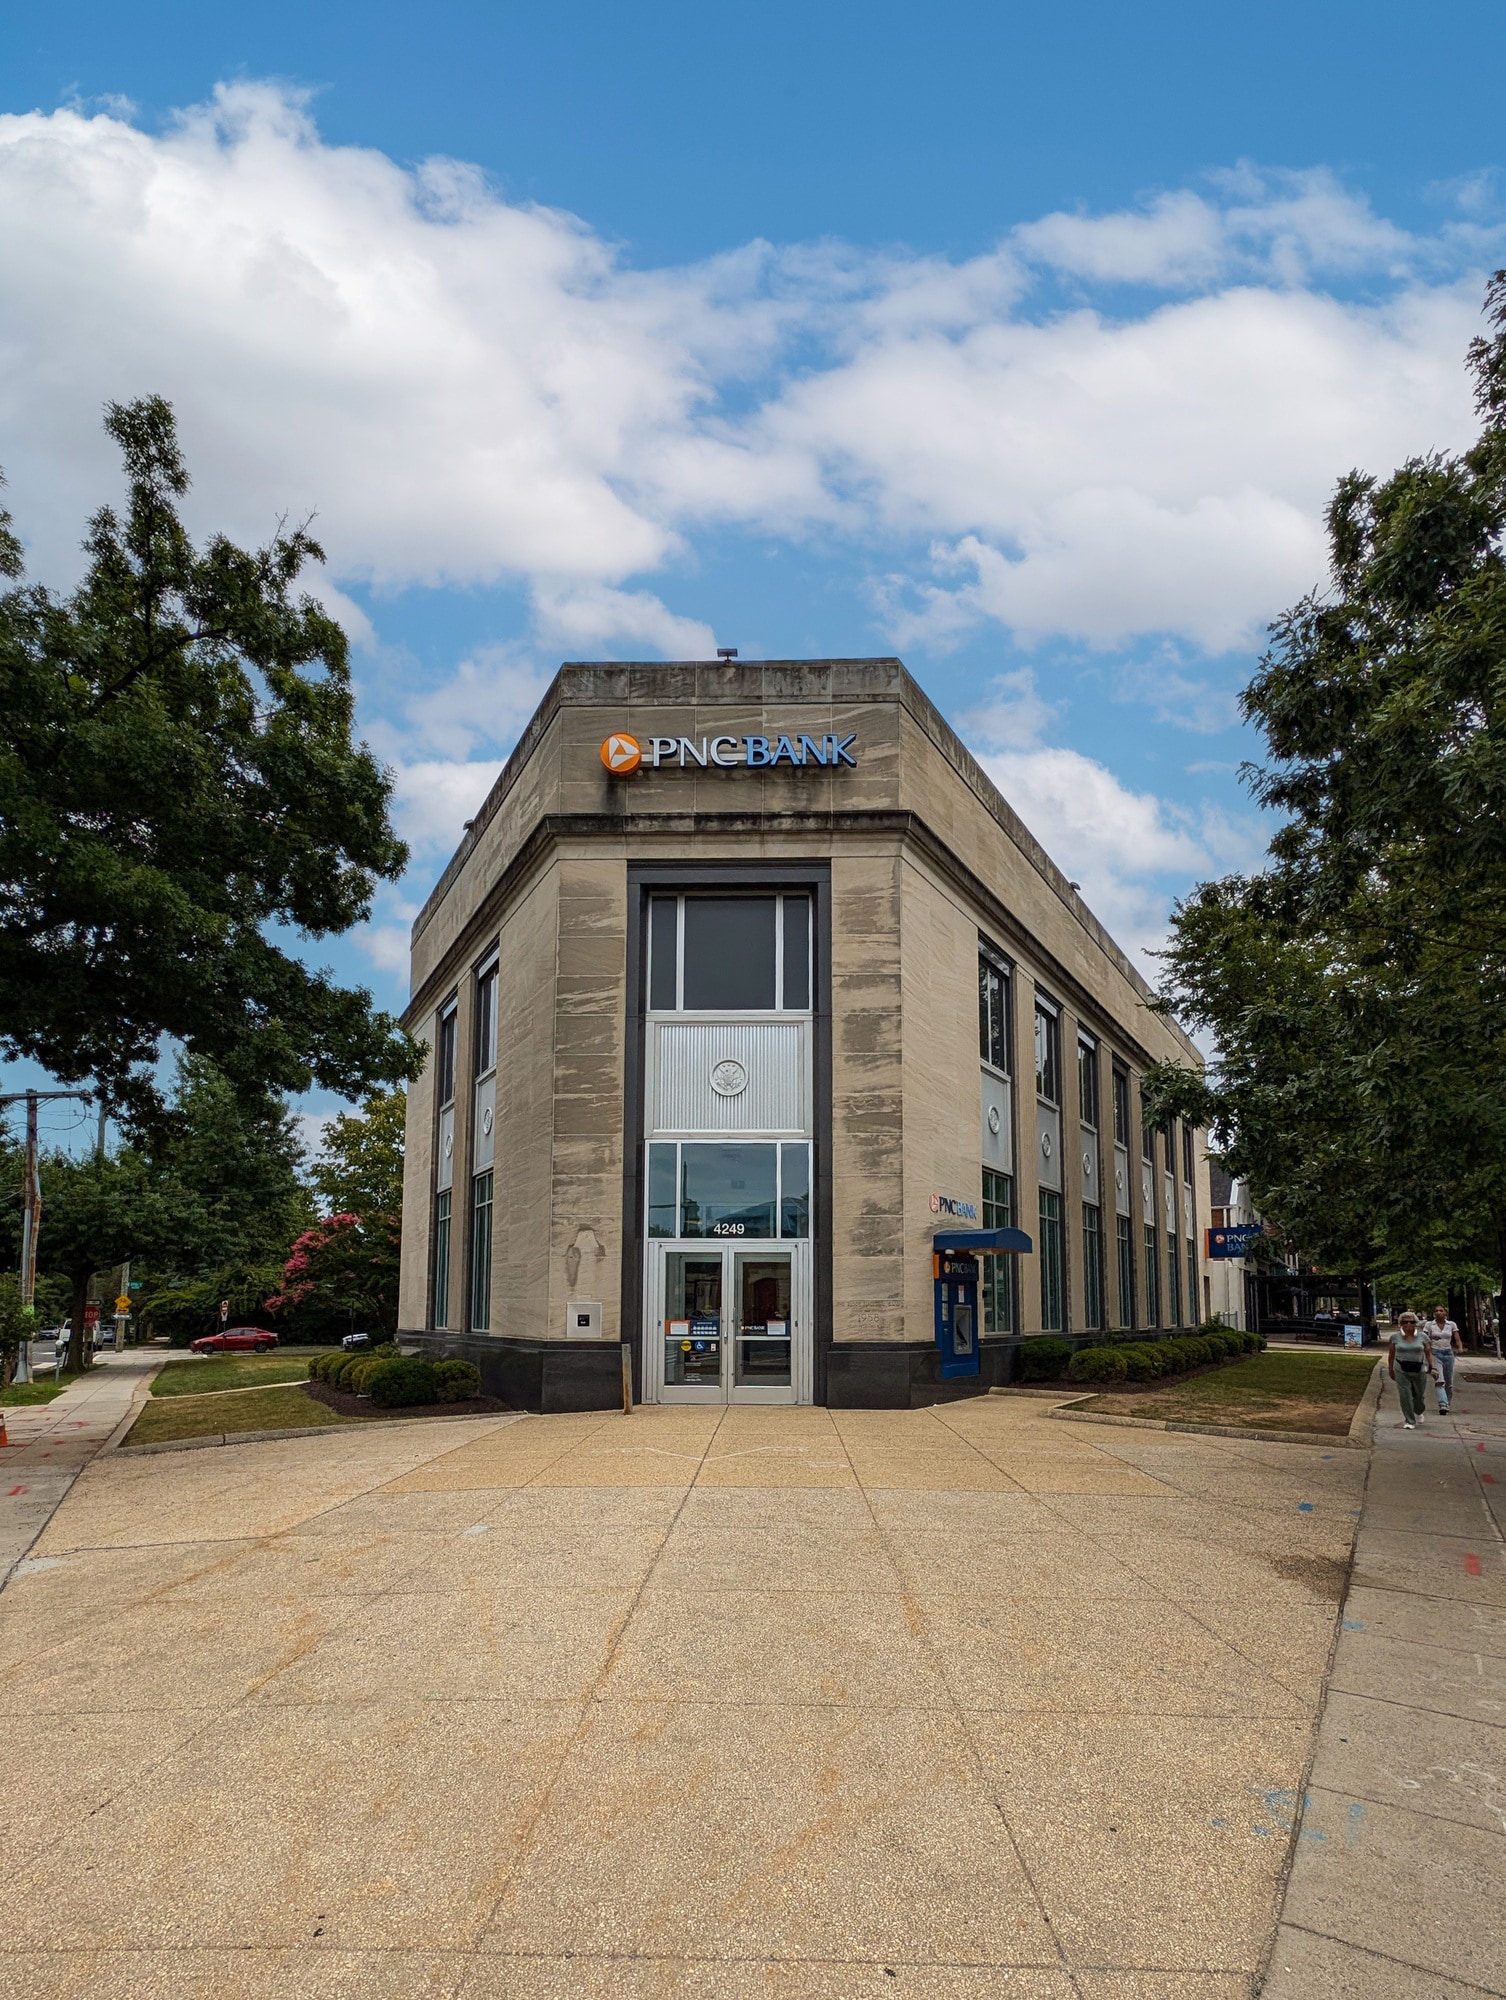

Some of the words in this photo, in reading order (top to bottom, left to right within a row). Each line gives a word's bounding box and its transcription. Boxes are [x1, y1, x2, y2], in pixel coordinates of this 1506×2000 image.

[648, 735, 738, 770] PNC
[741, 733, 858, 769] BANK
[939, 1196, 957, 1216] PNC
[957, 1201, 977, 1220] BANK
[713, 1223, 745, 1235] 4249
[1226, 1243, 1247, 1252] BAN
[951, 1262, 965, 1274] PNC
[85, 1311, 99, 1319] TOP
